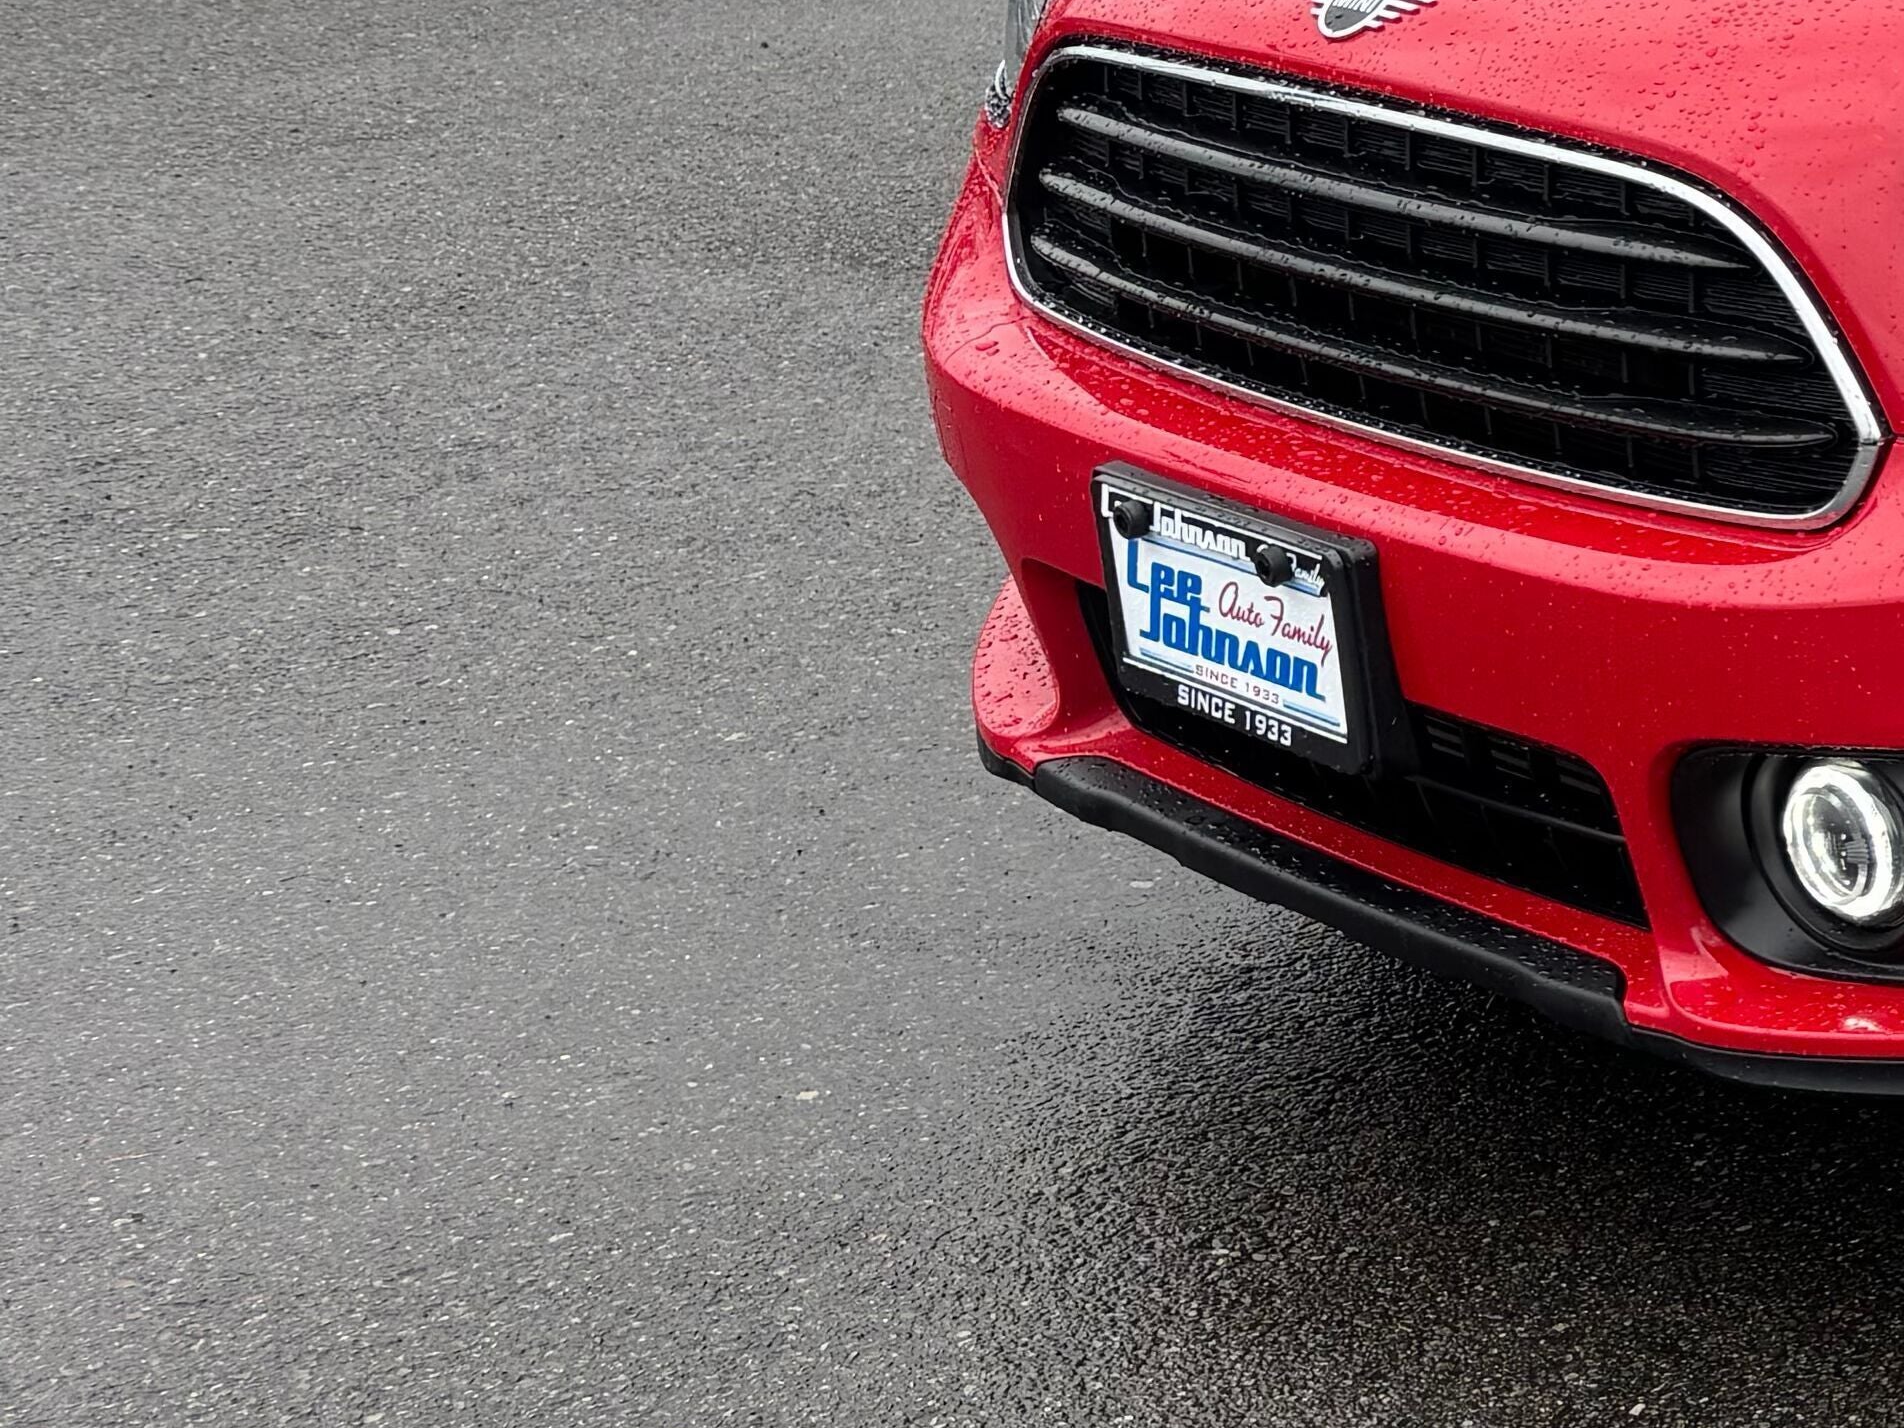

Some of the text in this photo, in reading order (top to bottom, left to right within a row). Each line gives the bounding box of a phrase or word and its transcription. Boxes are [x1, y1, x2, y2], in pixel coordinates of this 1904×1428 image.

[1127, 539, 1212, 613] Lee
[1139, 594, 1326, 703] Johnson
[1218, 581, 1333, 669] Auto Family
[1177, 683, 1293, 748] SINCE 1933
[1194, 664, 1281, 706] SINCE 1933
